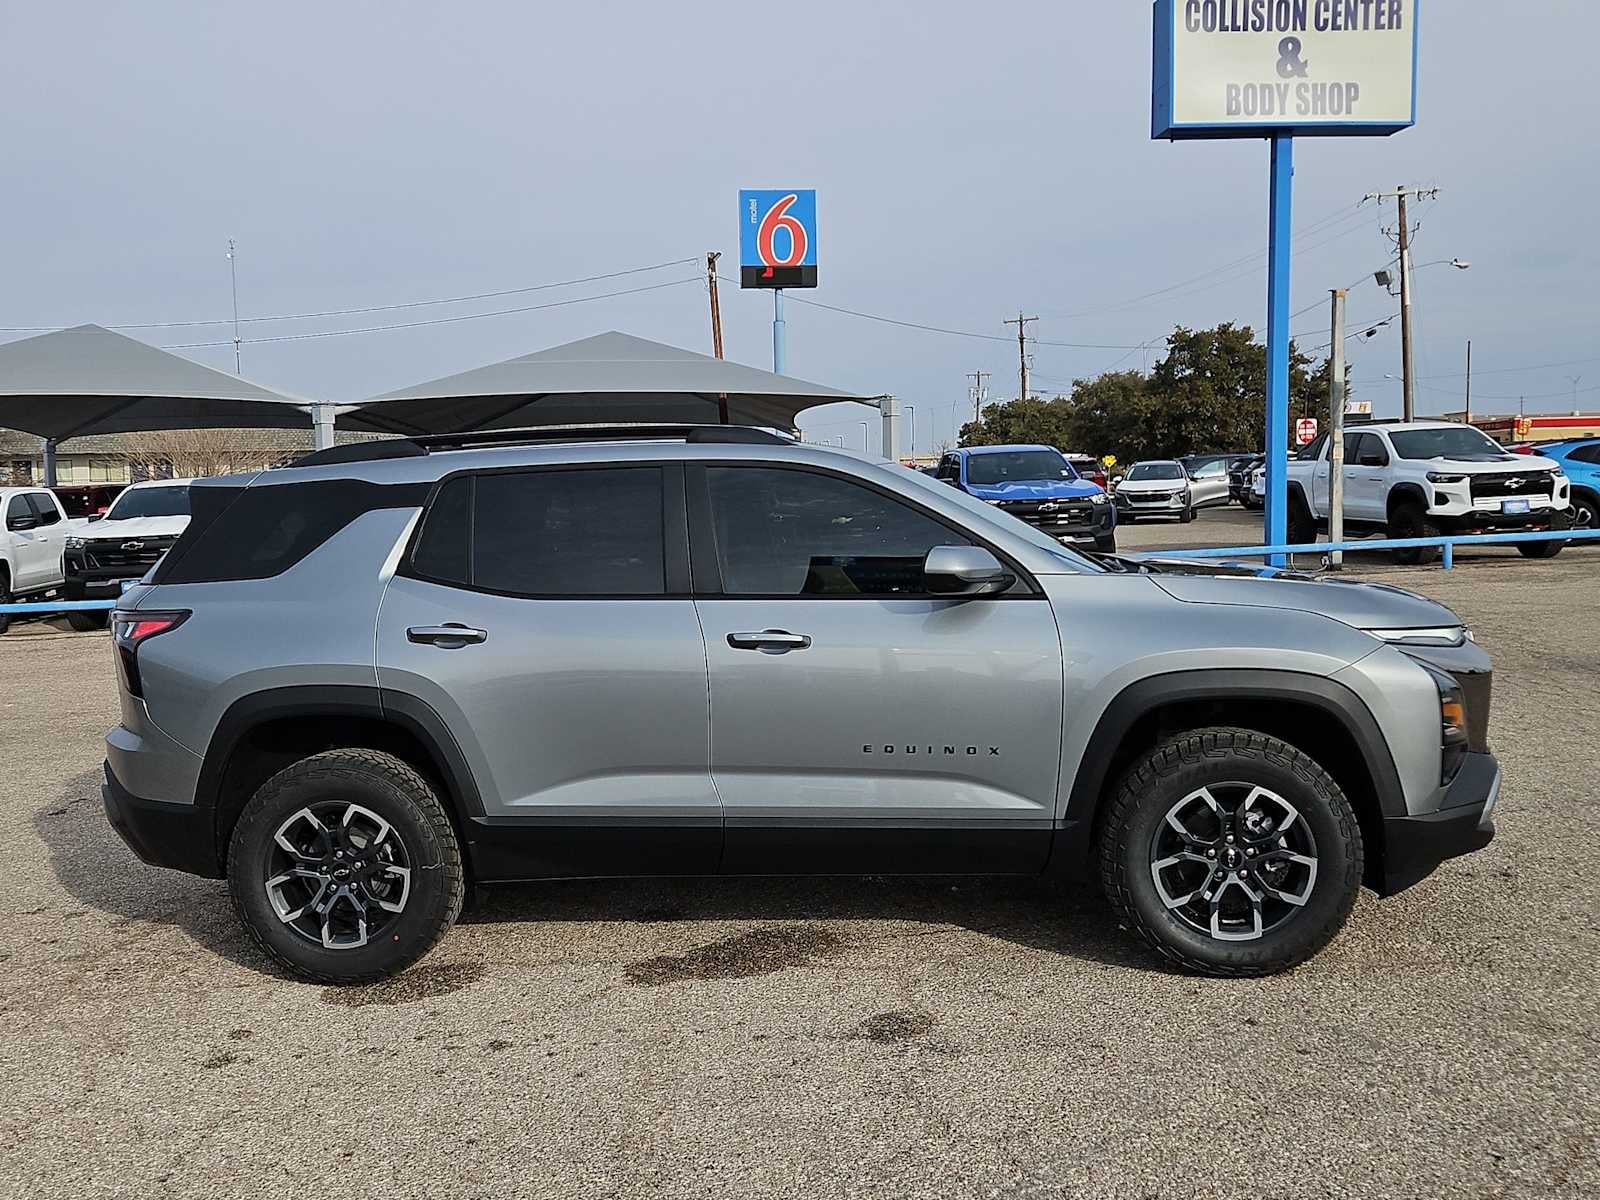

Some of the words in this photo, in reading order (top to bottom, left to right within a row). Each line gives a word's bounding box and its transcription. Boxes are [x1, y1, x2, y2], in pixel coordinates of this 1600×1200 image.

[1185, 0, 1306, 32] COLLISION
[1314, 0, 1402, 31] CENTER
[1276, 36, 1308, 79] &
[1226, 82, 1290, 116] BODY
[1296, 82, 1360, 115] SHOP
[749, 199, 757, 224] motel
[756, 193, 808, 267] 6
[862, 744, 1000, 756] EQUINOX
